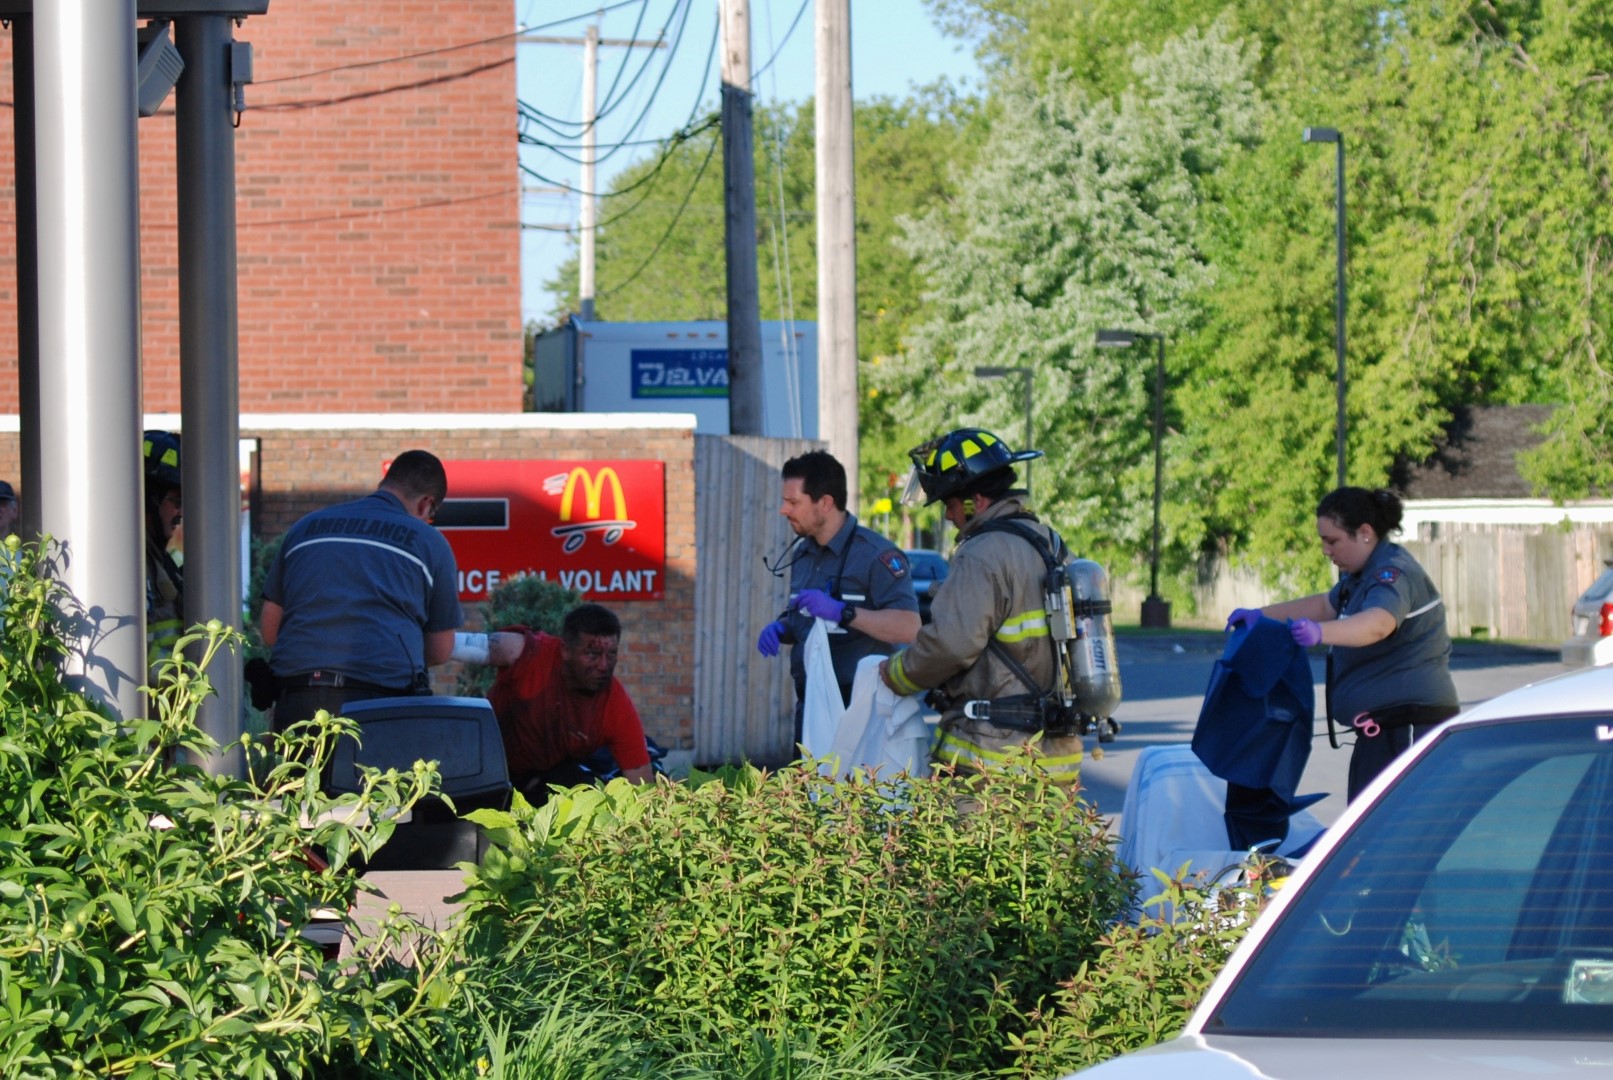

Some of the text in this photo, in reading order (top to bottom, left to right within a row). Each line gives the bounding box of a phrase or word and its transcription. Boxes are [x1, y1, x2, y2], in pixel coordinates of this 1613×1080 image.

[637, 362, 729, 386] DELVA
[305, 518, 418, 547] AMBULANCE
[458, 570, 501, 593] ICE
[560, 570, 657, 593] VOLANT
